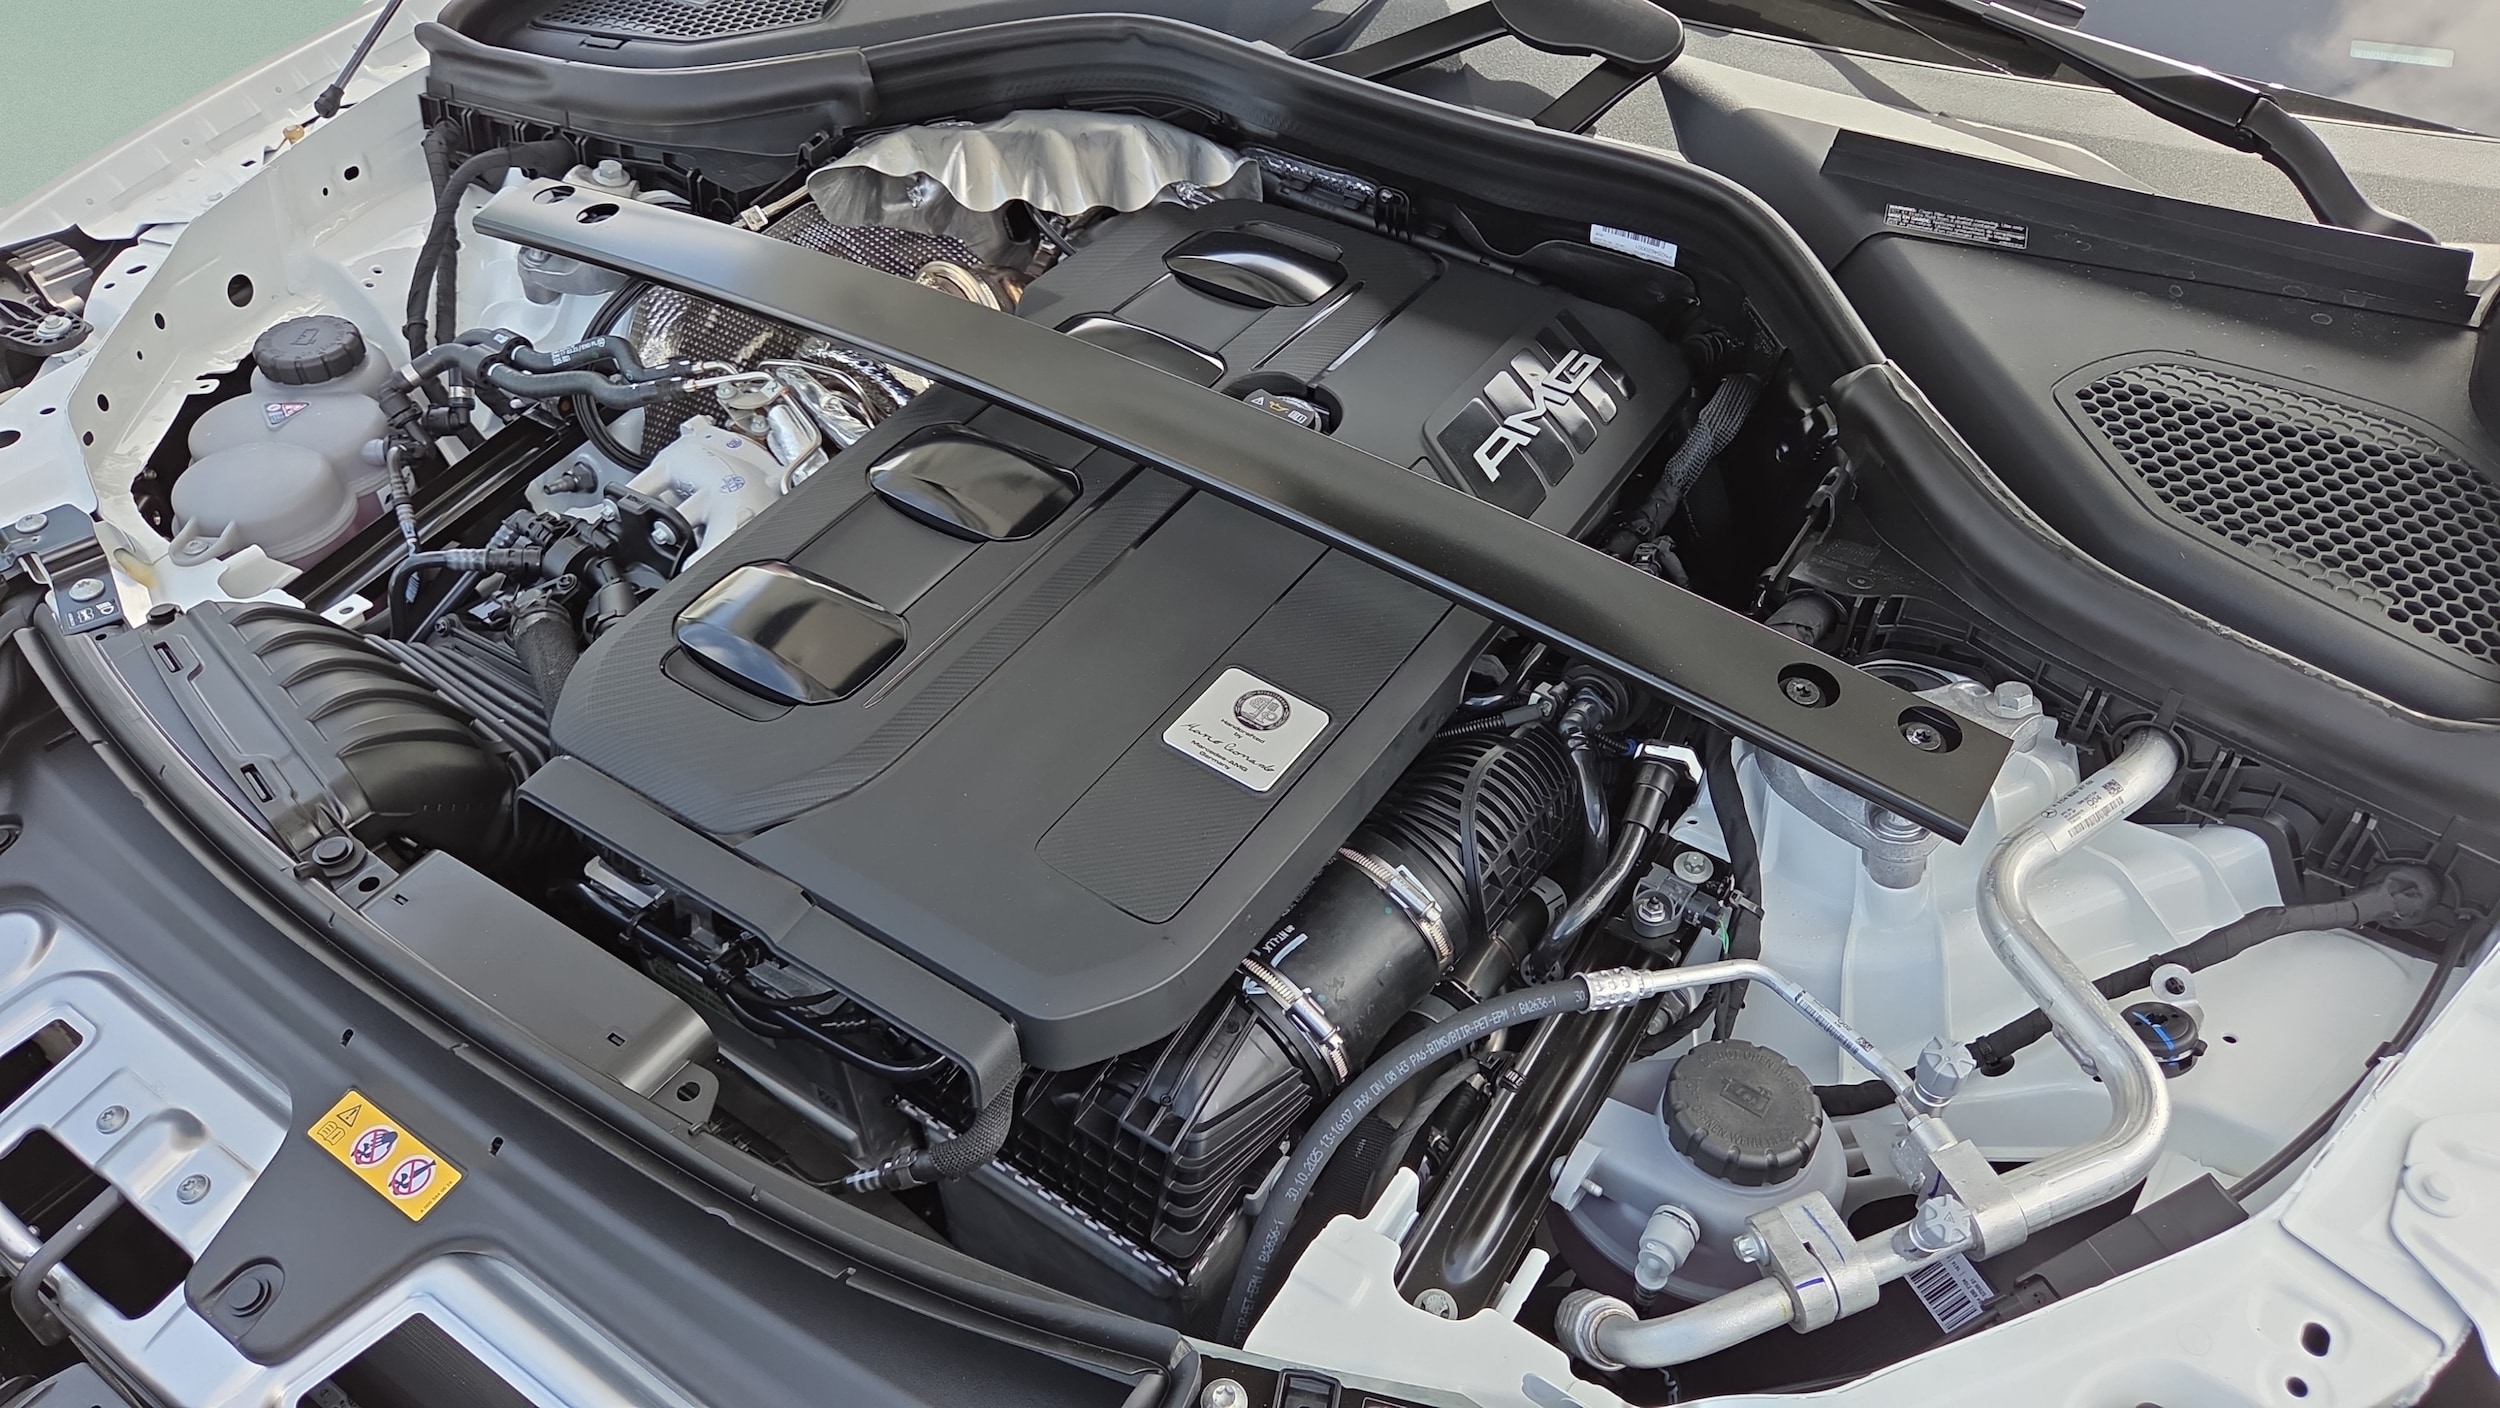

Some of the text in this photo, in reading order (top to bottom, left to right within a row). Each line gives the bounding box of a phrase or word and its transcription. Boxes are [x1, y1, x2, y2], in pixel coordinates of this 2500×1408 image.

[1473, 349, 1603, 483] AMG
[1220, 718, 1265, 744] Handcrafted
[1233, 732, 1243, 740] by
[1191, 740, 1248, 772] Mercedes-AMG
[1199, 751, 1231, 770] Germany
[1285, 1147, 1323, 1202] 30.10.2025
[1320, 1108, 1354, 1148] 13:16:07
[1353, 1092, 1373, 1112] PHX
[1370, 1077, 1385, 1095] DN
[1519, 994, 1556, 1015] BA2636-1
